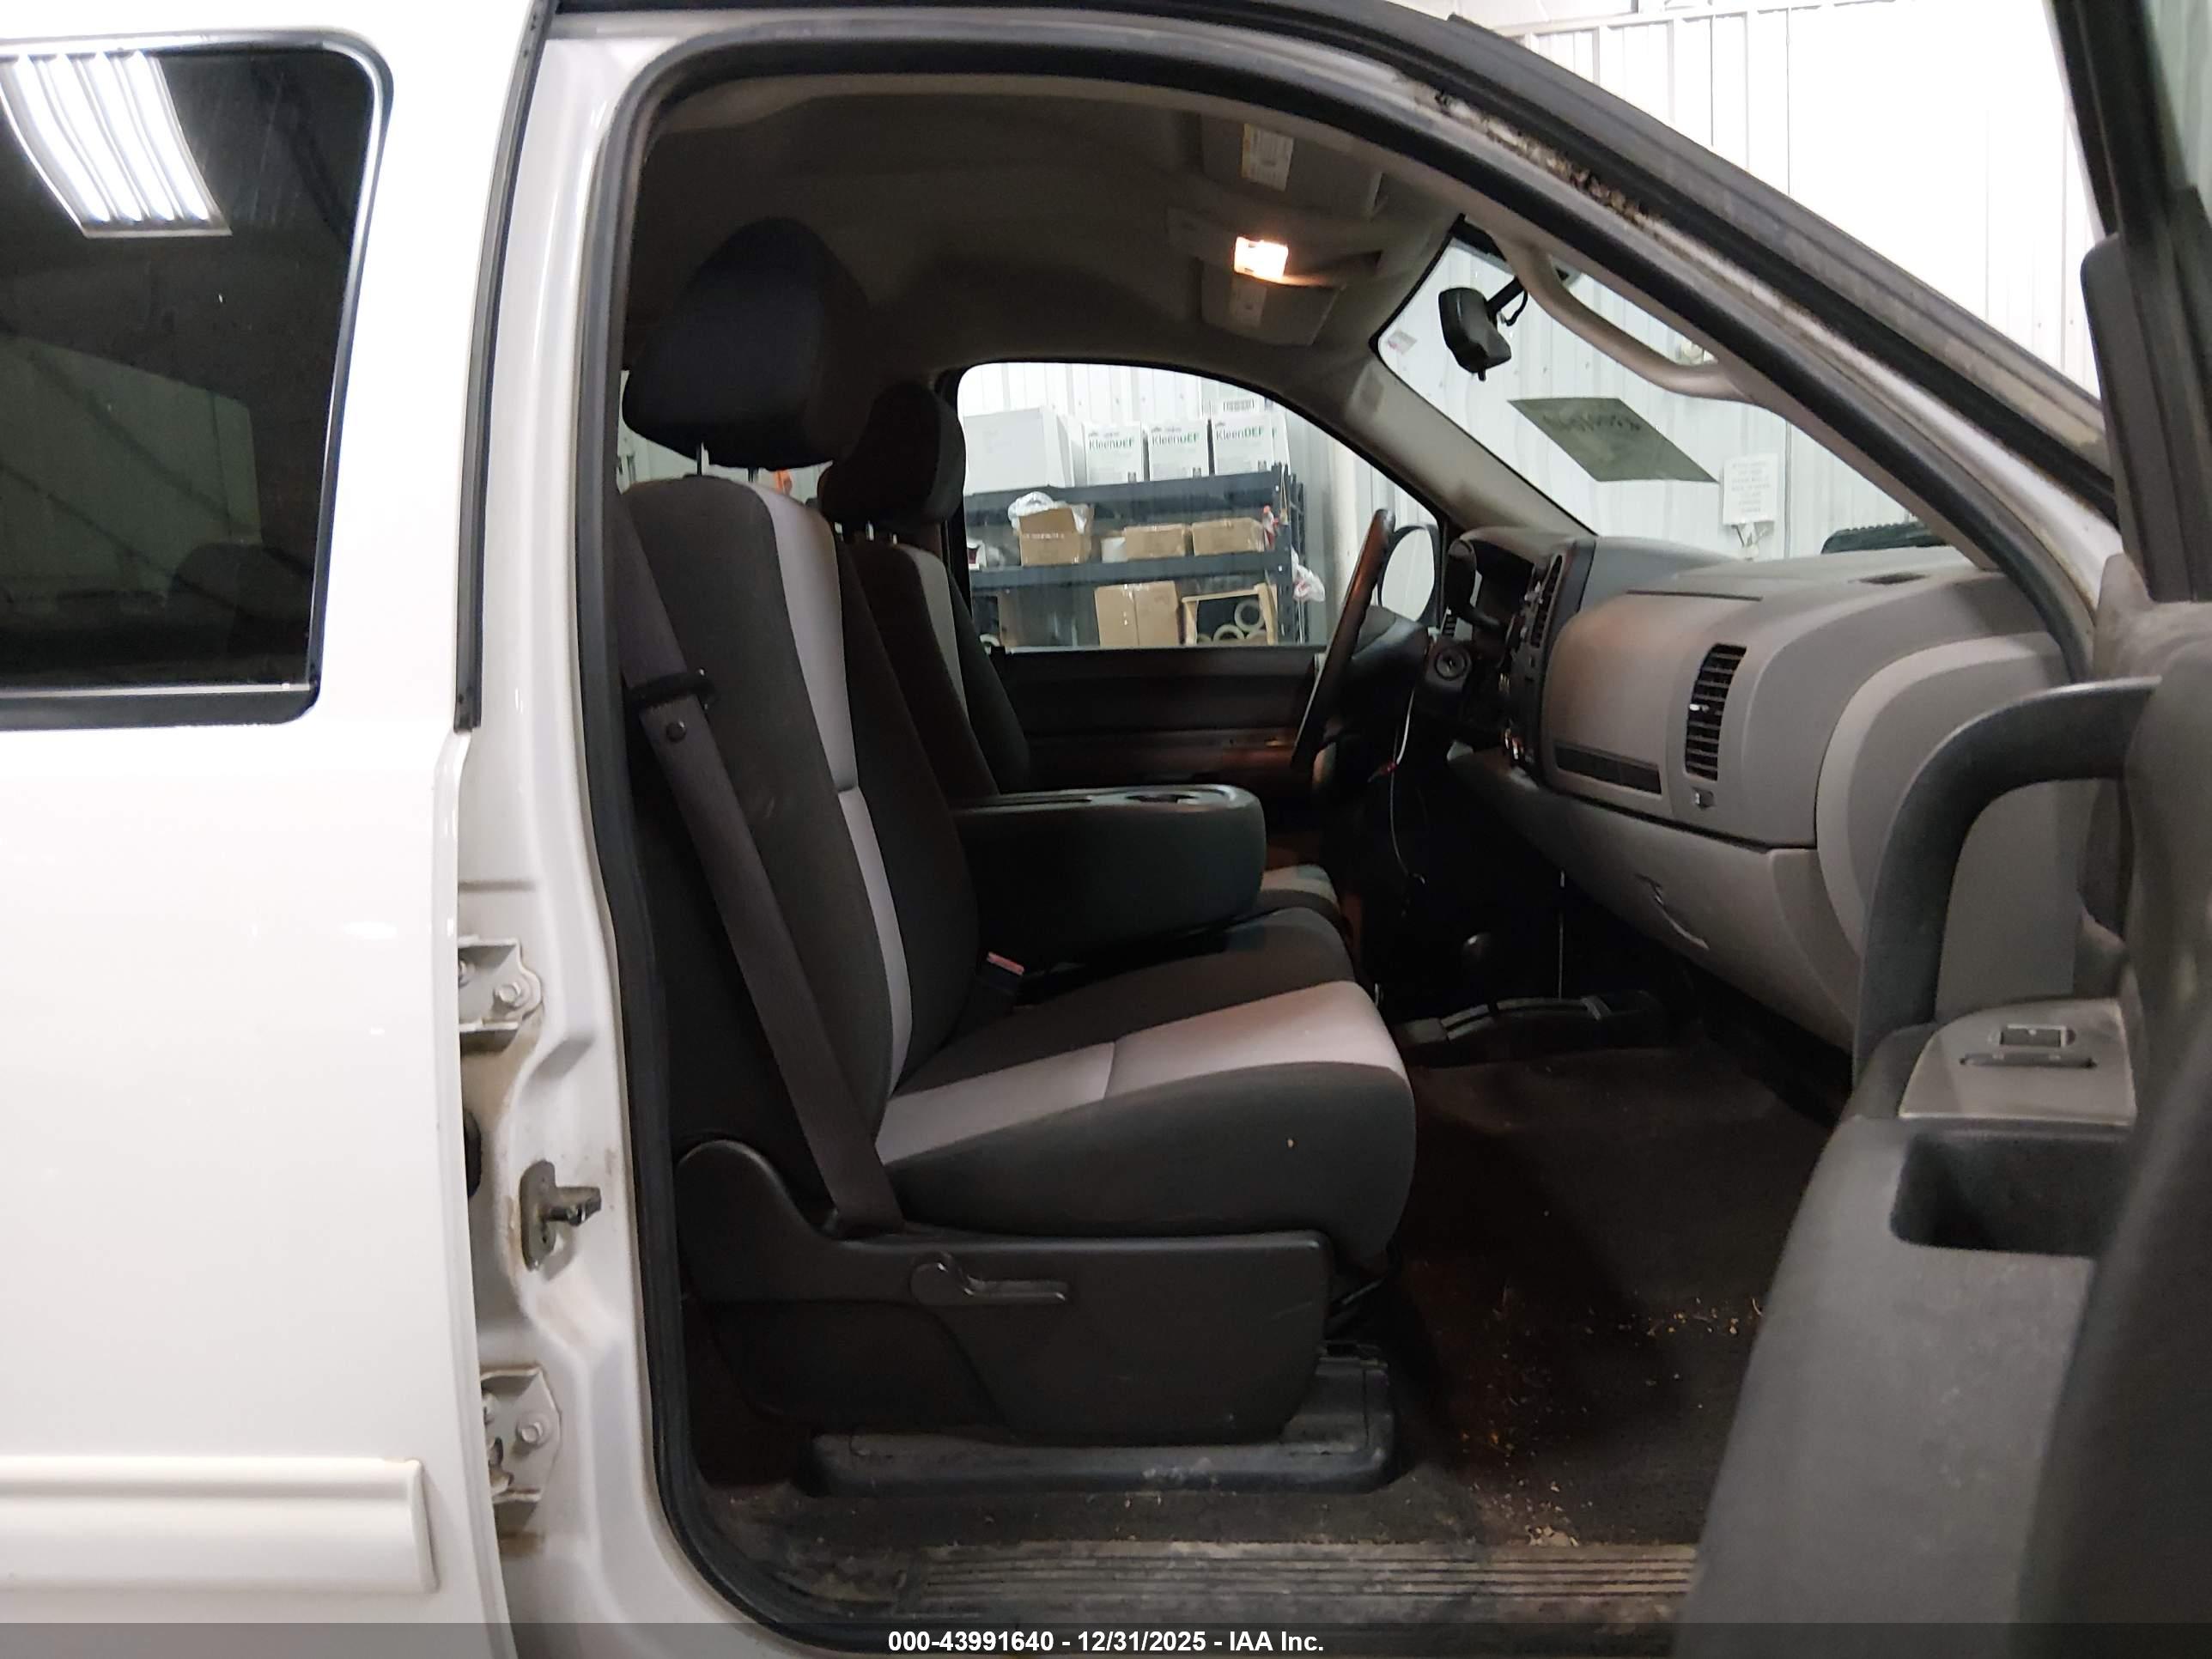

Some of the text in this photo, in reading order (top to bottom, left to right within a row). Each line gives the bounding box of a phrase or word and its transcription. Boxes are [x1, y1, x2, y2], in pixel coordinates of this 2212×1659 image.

[1152, 432, 1200, 446] KleenDEF
[1216, 426, 1264, 441] KleenDEF
[1089, 438, 1134, 450] KleenDEF
